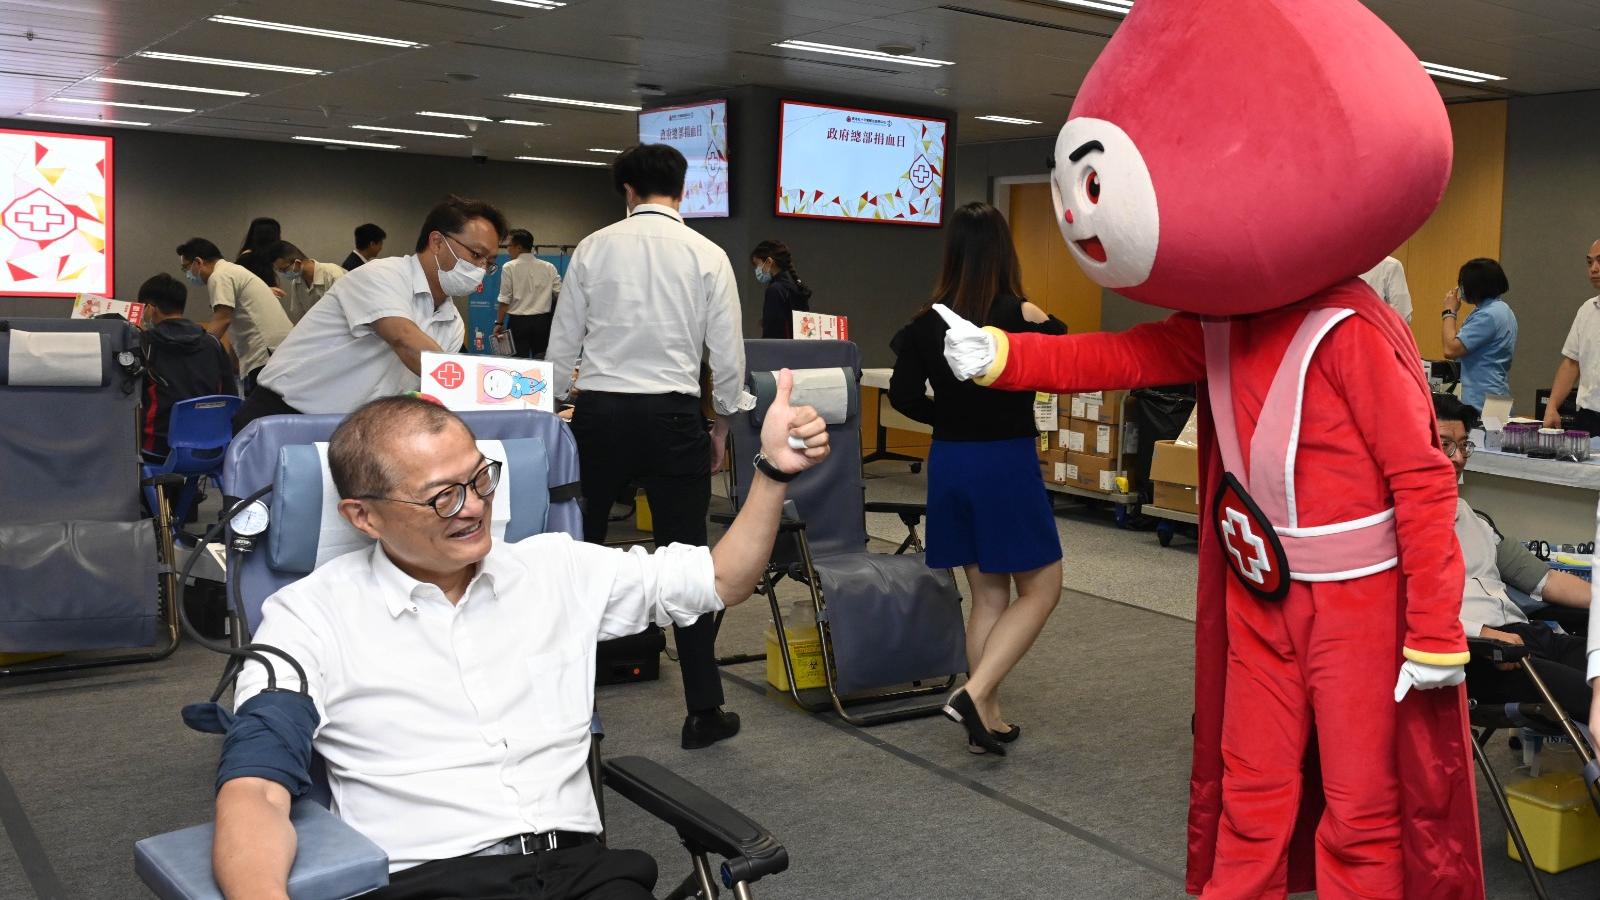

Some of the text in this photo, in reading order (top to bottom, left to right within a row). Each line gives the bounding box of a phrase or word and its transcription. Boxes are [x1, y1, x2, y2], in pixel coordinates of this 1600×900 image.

[827, 127, 905, 147] 政府總部捐血日
